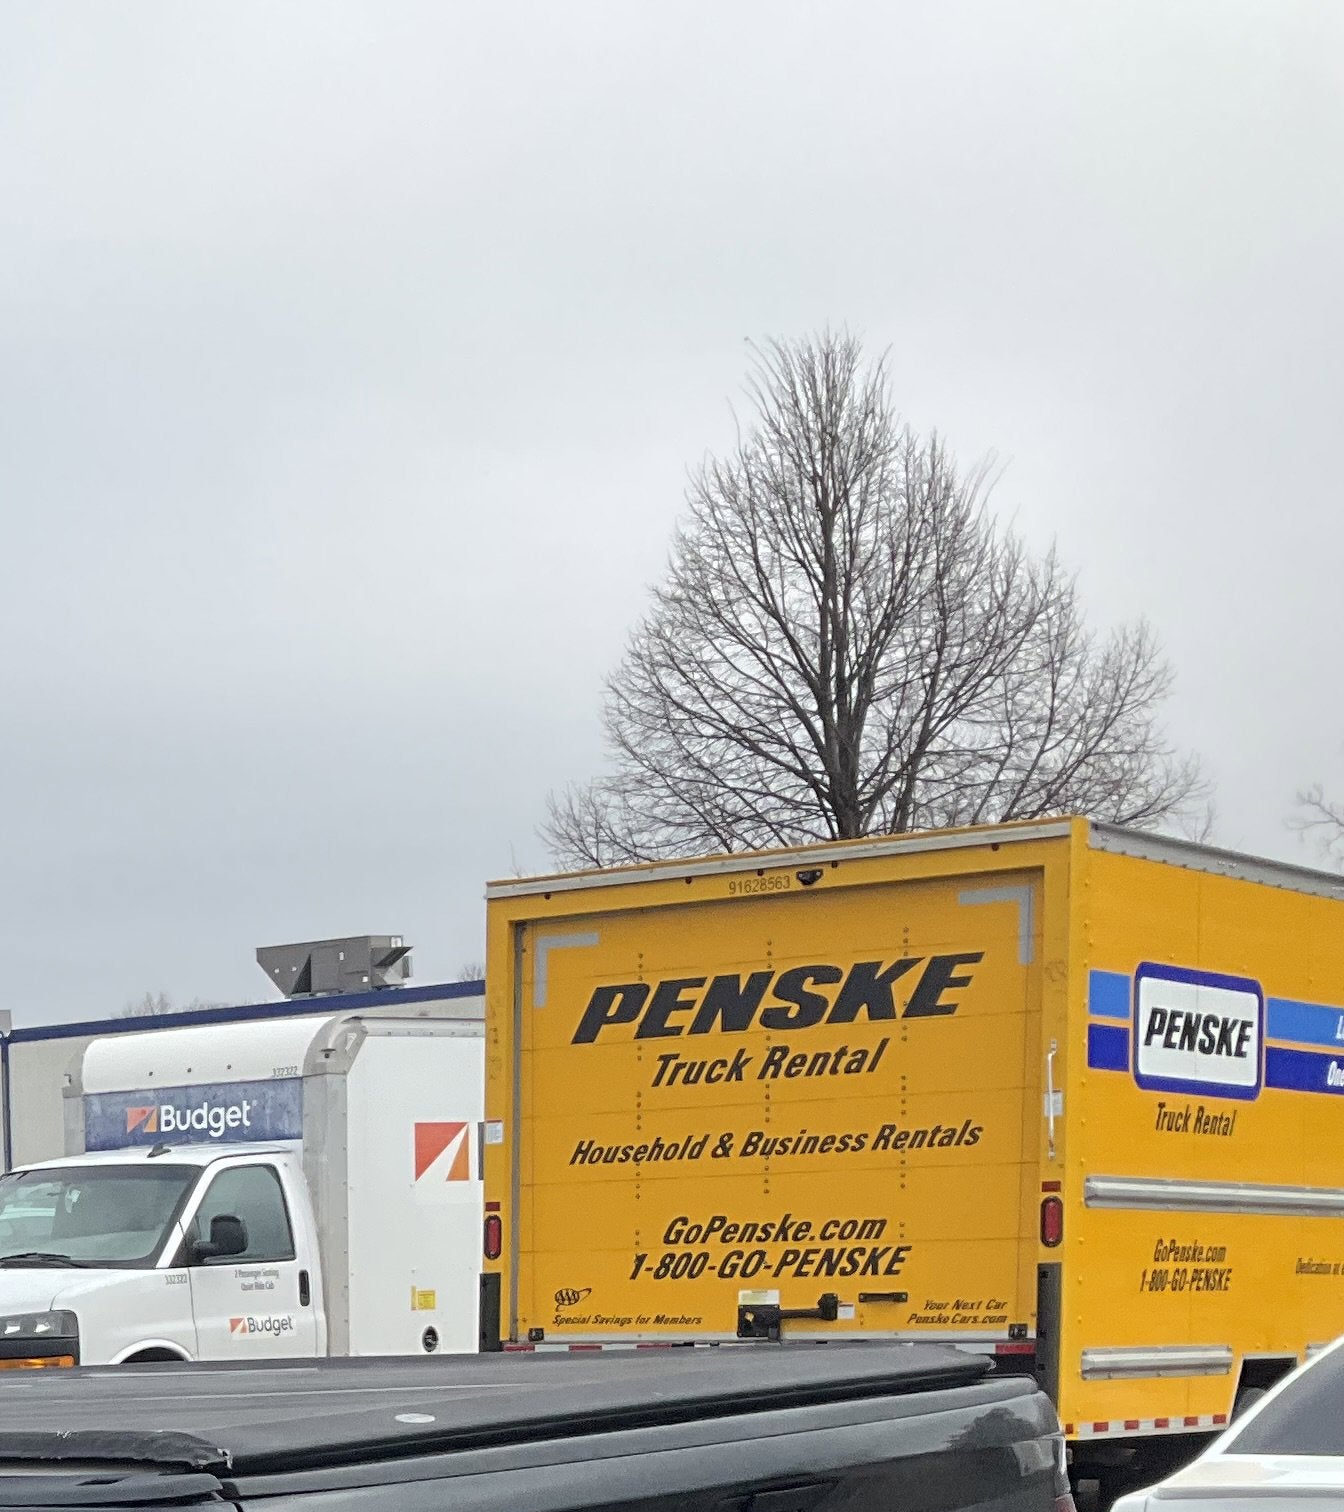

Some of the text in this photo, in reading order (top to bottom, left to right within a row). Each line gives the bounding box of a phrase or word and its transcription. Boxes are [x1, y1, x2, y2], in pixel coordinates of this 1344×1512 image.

[728, 875, 791, 895] 91628563
[570, 951, 985, 1045] PENSKE
[1144, 1007, 1254, 1058] PENSKE
[651, 1038, 890, 1087] Truck Rental
[160, 1100, 251, 1138] Budget
[1155, 1102, 1237, 1136] Truck Rental
[569, 1120, 983, 1166] Household & Business Rentals
[662, 1214, 888, 1246] GoPenske.com
[629, 1245, 912, 1281] 1-800-GO-PENSKE
[1153, 1238, 1227, 1262] GoPenske.com
[1139, 1268, 1233, 1292] 1-800-GO-PENSKE
[552, 1314, 703, 1327] Special Savings for Members
[923, 1298, 1008, 1311] Your Next Car
[247, 1315, 294, 1336] Budget
